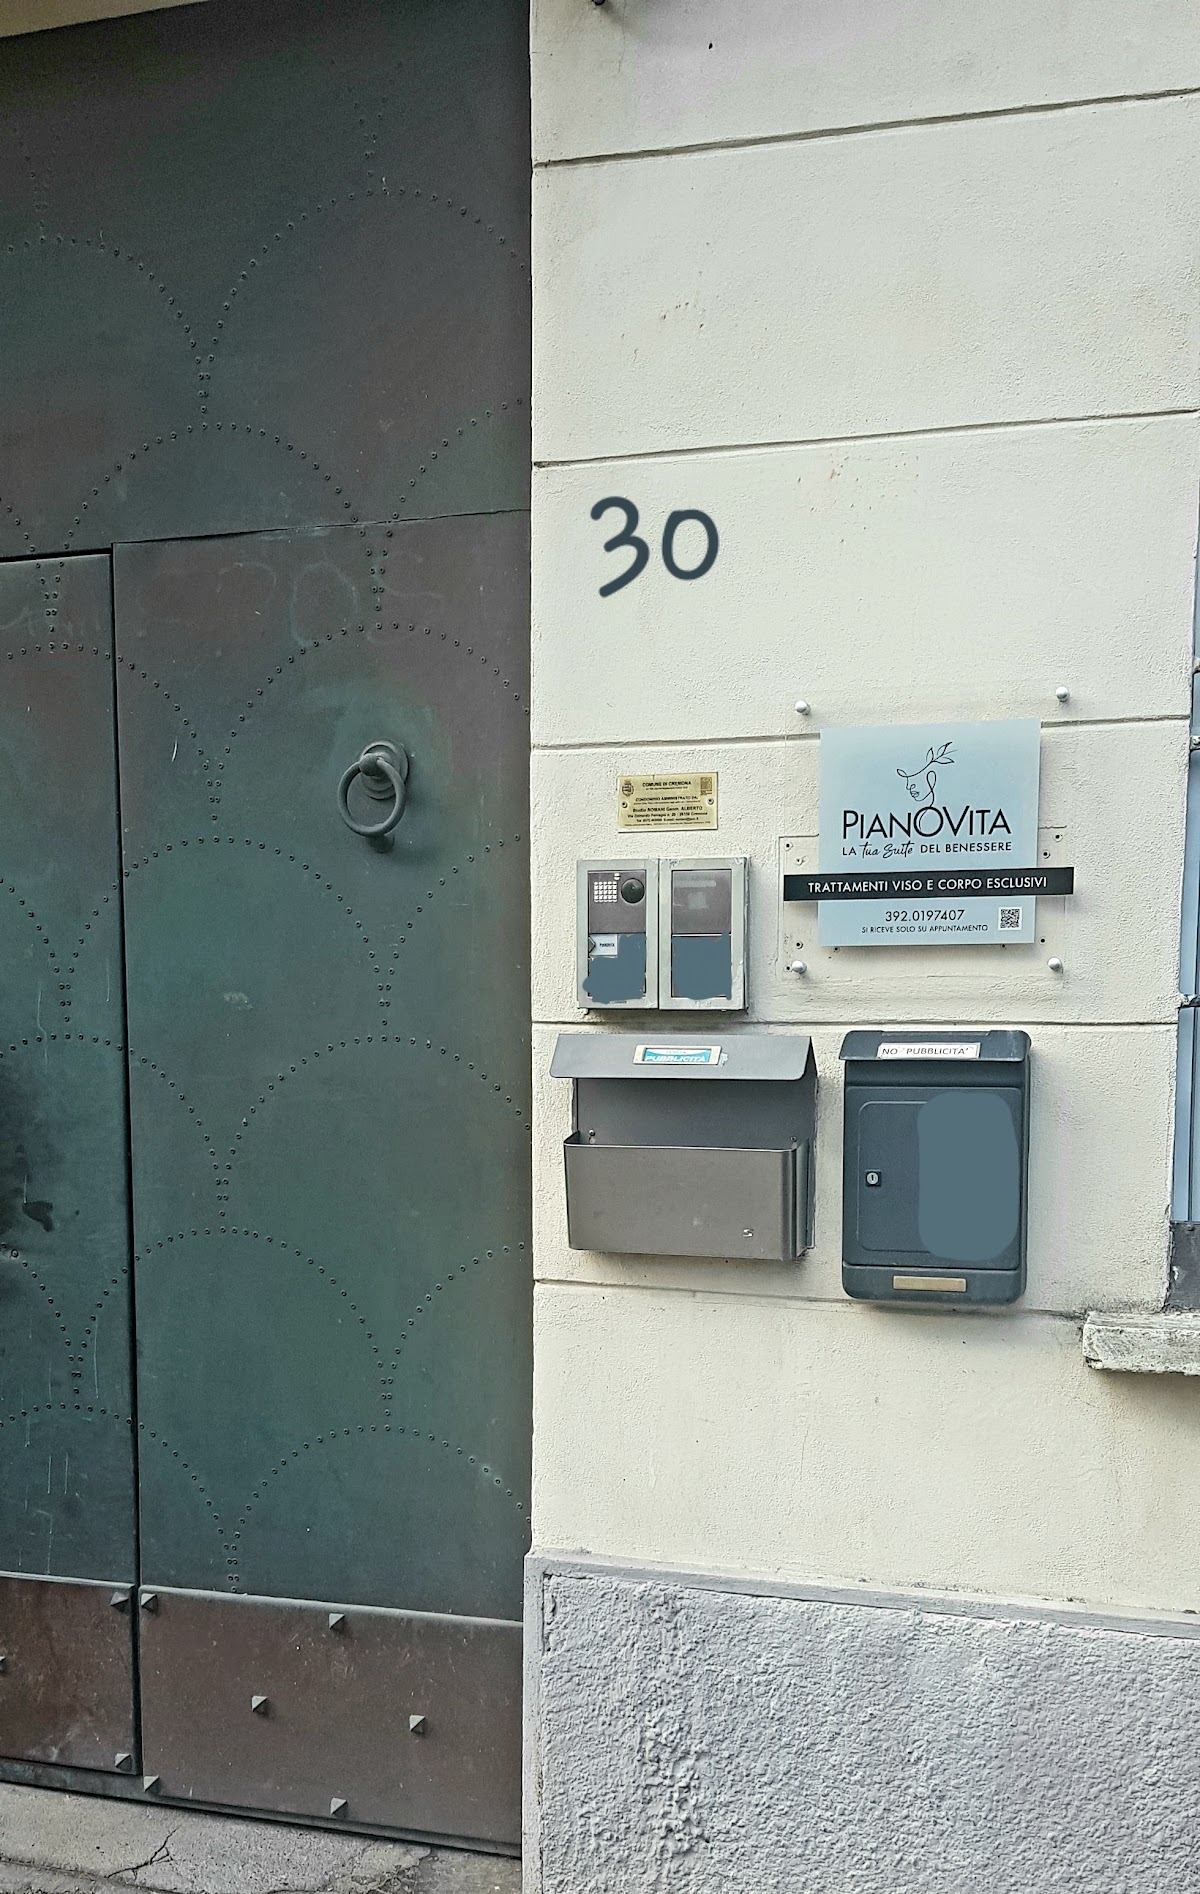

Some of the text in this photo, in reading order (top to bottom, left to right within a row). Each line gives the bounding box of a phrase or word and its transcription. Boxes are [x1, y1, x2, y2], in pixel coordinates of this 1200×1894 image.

[843, 805, 1012, 840] PIANOVITA
[842, 840, 1012, 859] LA tua Suite DEL BENESSERE
[808, 877, 1047, 893] TRATTAMENTI VISO E CORPO ESCLUSIVI
[885, 909, 965, 922] 392.0197407
[896, 925, 916, 933] SOLO
[929, 924, 988, 932] APPUNTAMENTO
[881, 1047, 898, 1055] NO
